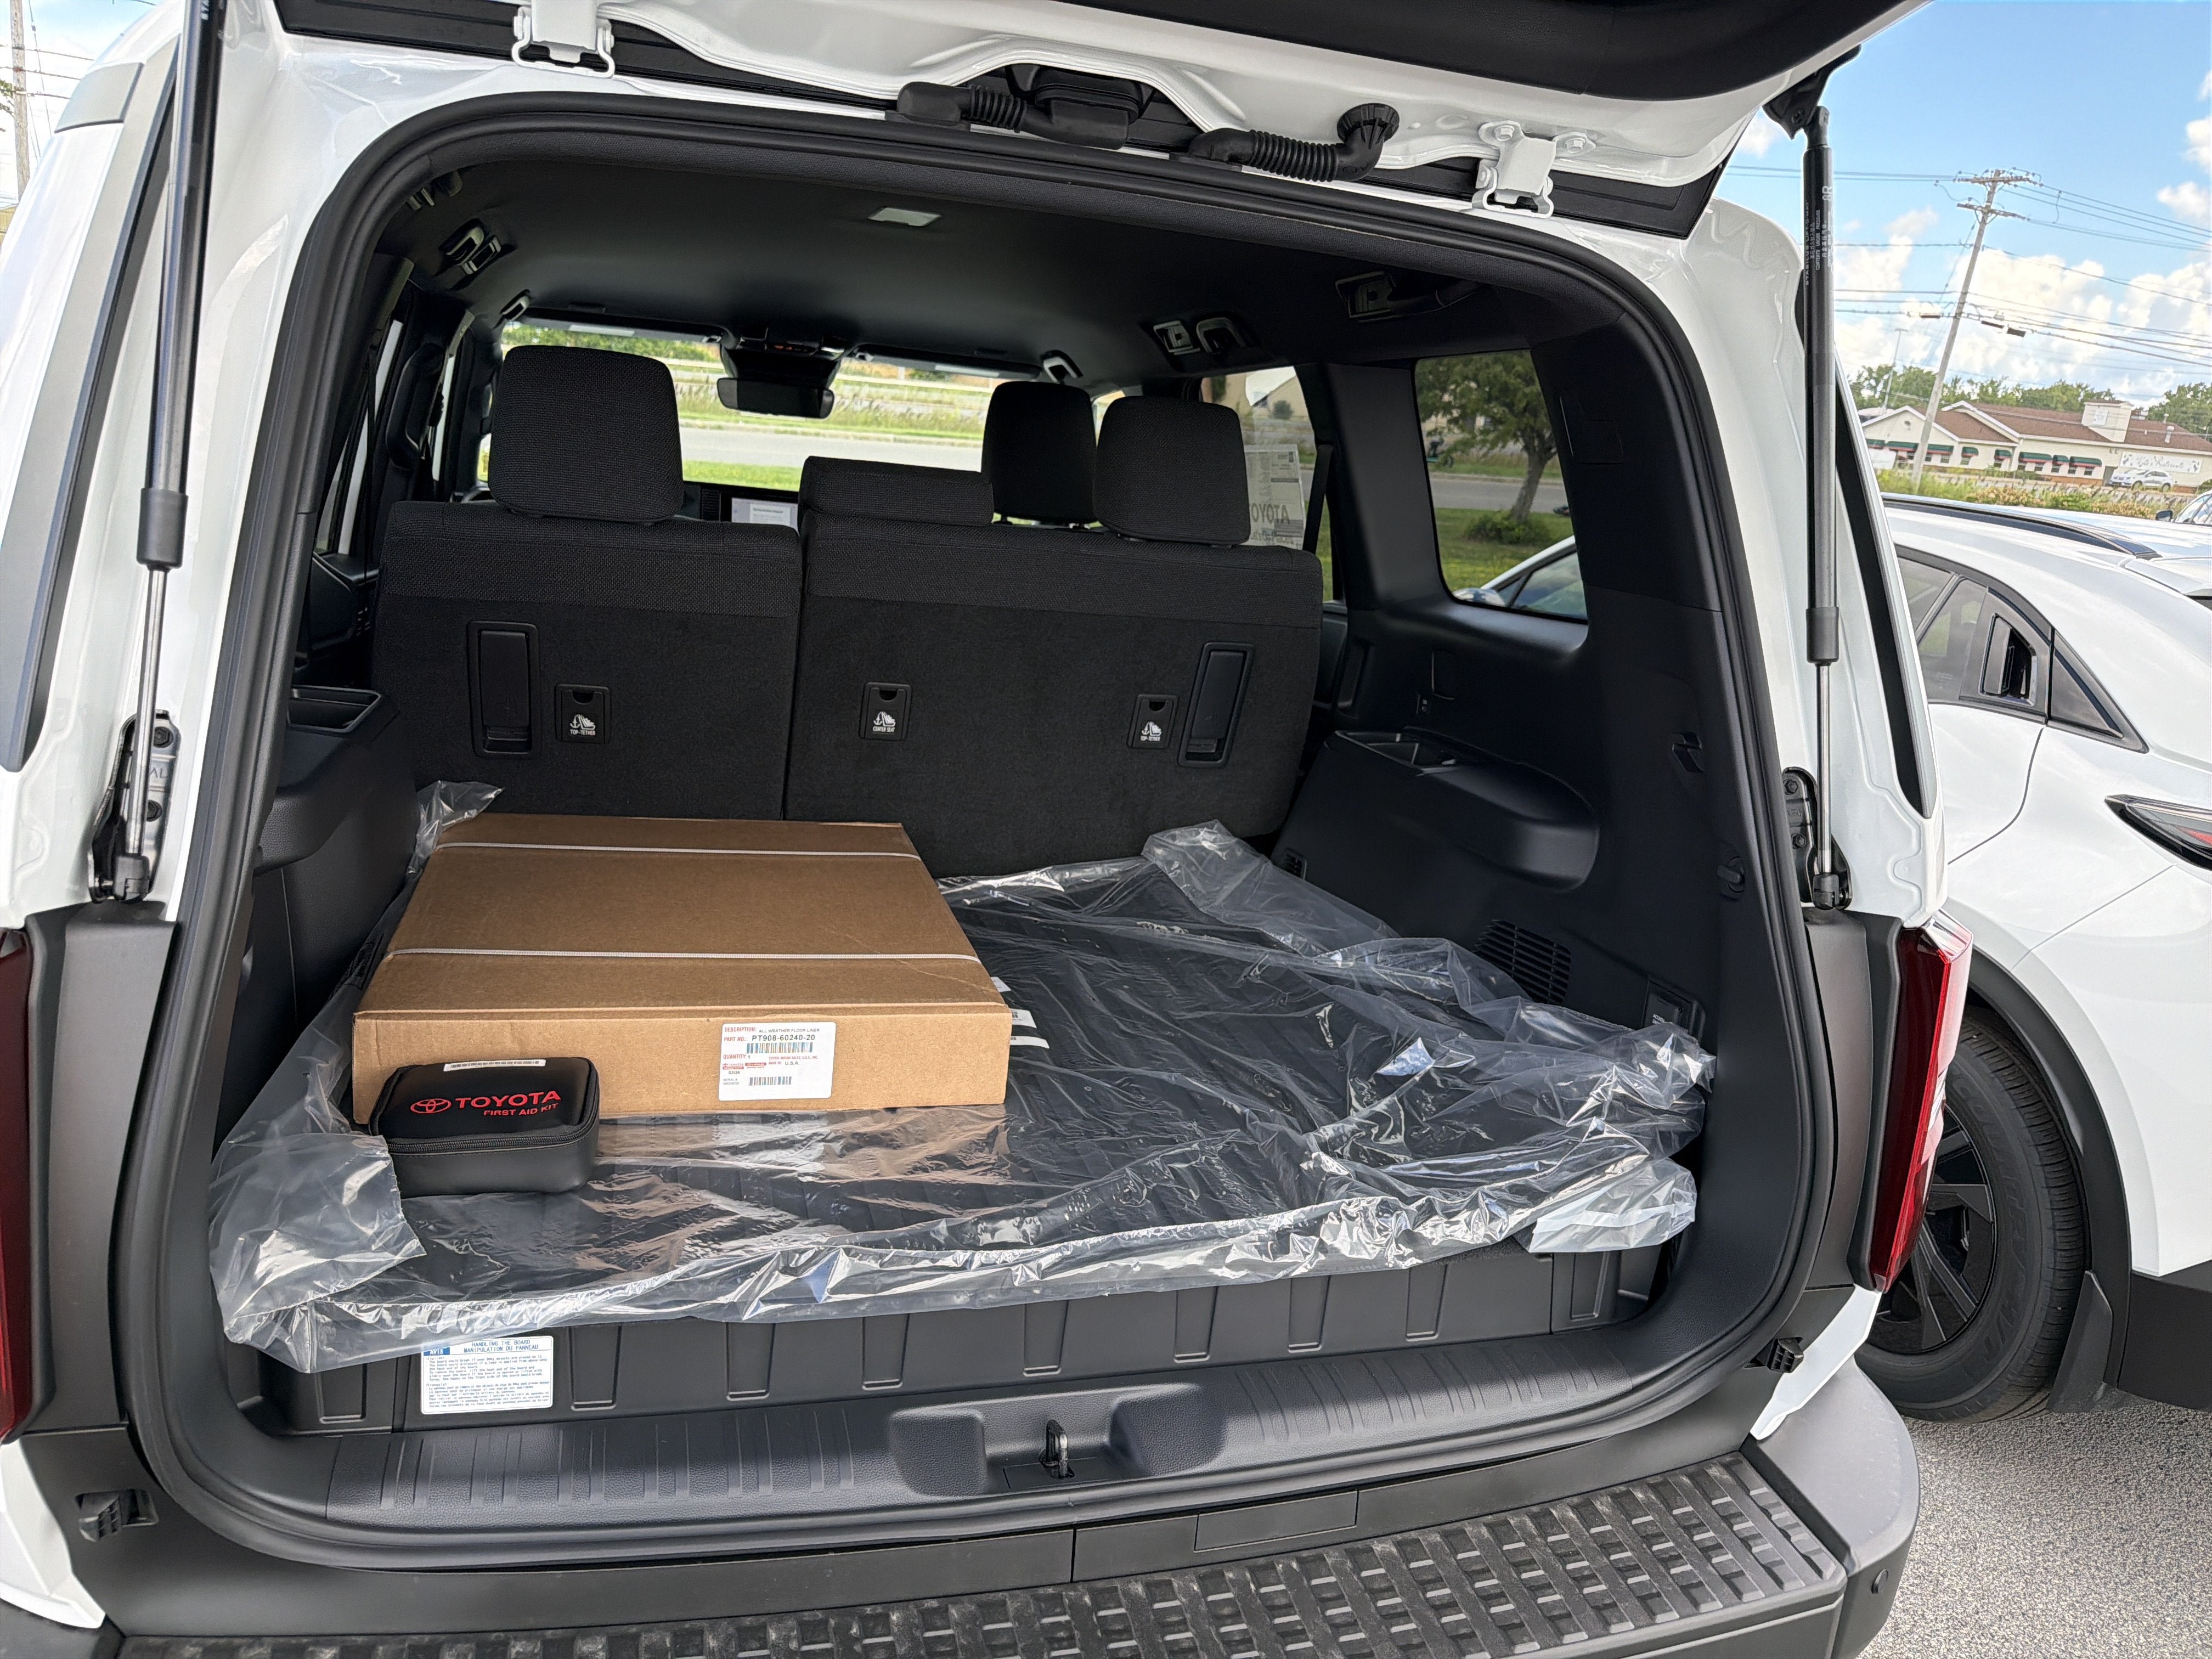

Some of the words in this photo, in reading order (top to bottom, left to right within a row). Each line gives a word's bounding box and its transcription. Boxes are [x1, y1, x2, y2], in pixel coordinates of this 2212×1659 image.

[1251, 503, 1290, 524] OYOTA
[455, 1090, 561, 1109] TOYOTA
[483, 1109, 517, 1117] FIRST
[518, 1107, 538, 1116] AID
[541, 1103, 560, 1113] KIT
